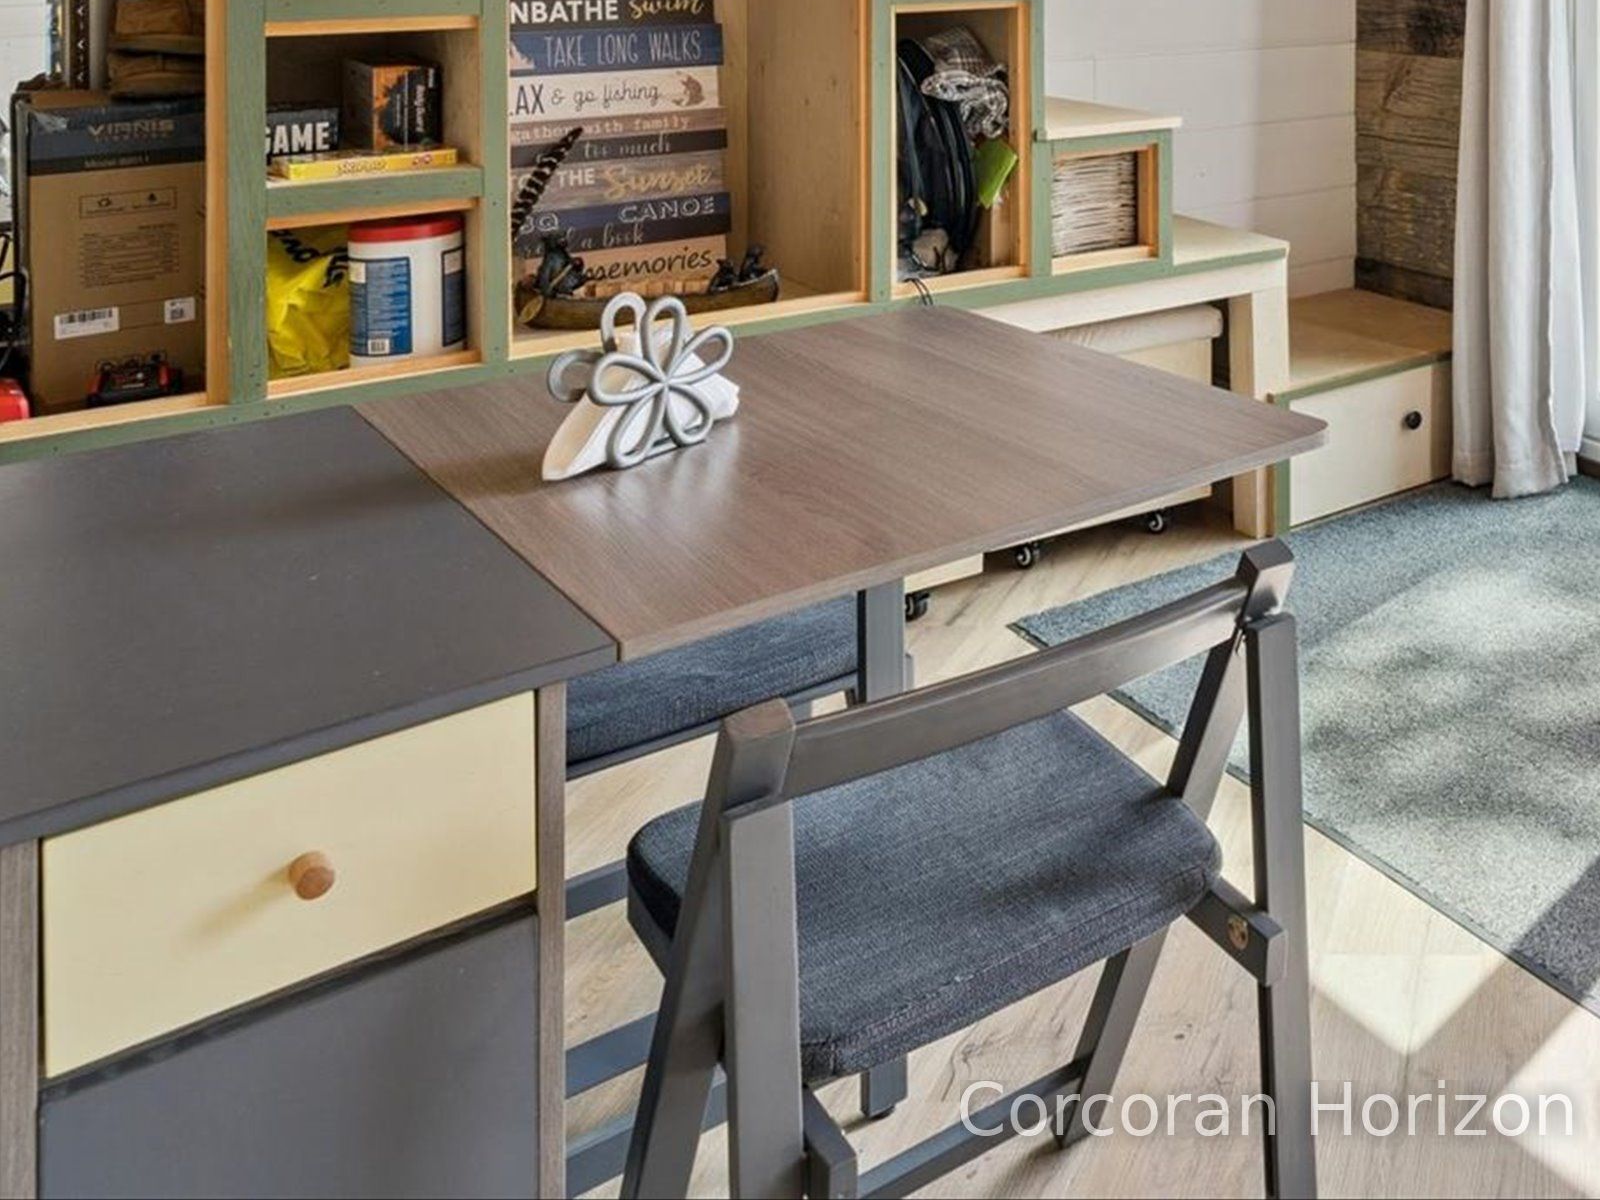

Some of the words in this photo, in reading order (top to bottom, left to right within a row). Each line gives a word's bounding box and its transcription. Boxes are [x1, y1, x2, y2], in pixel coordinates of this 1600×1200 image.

[544, 35, 587, 69] TAKE
[597, 33, 640, 65] LONG
[648, 30, 702, 63] WALKS
[573, 90, 600, 112] go
[603, 81, 662, 109] fishing
[583, 119, 623, 135] with
[633, 115, 690, 132] family
[620, 132, 672, 156] much
[556, 167, 595, 188] THE
[603, 162, 713, 200] Sunset
[618, 196, 715, 223] CANOE
[602, 220, 645, 246] book
